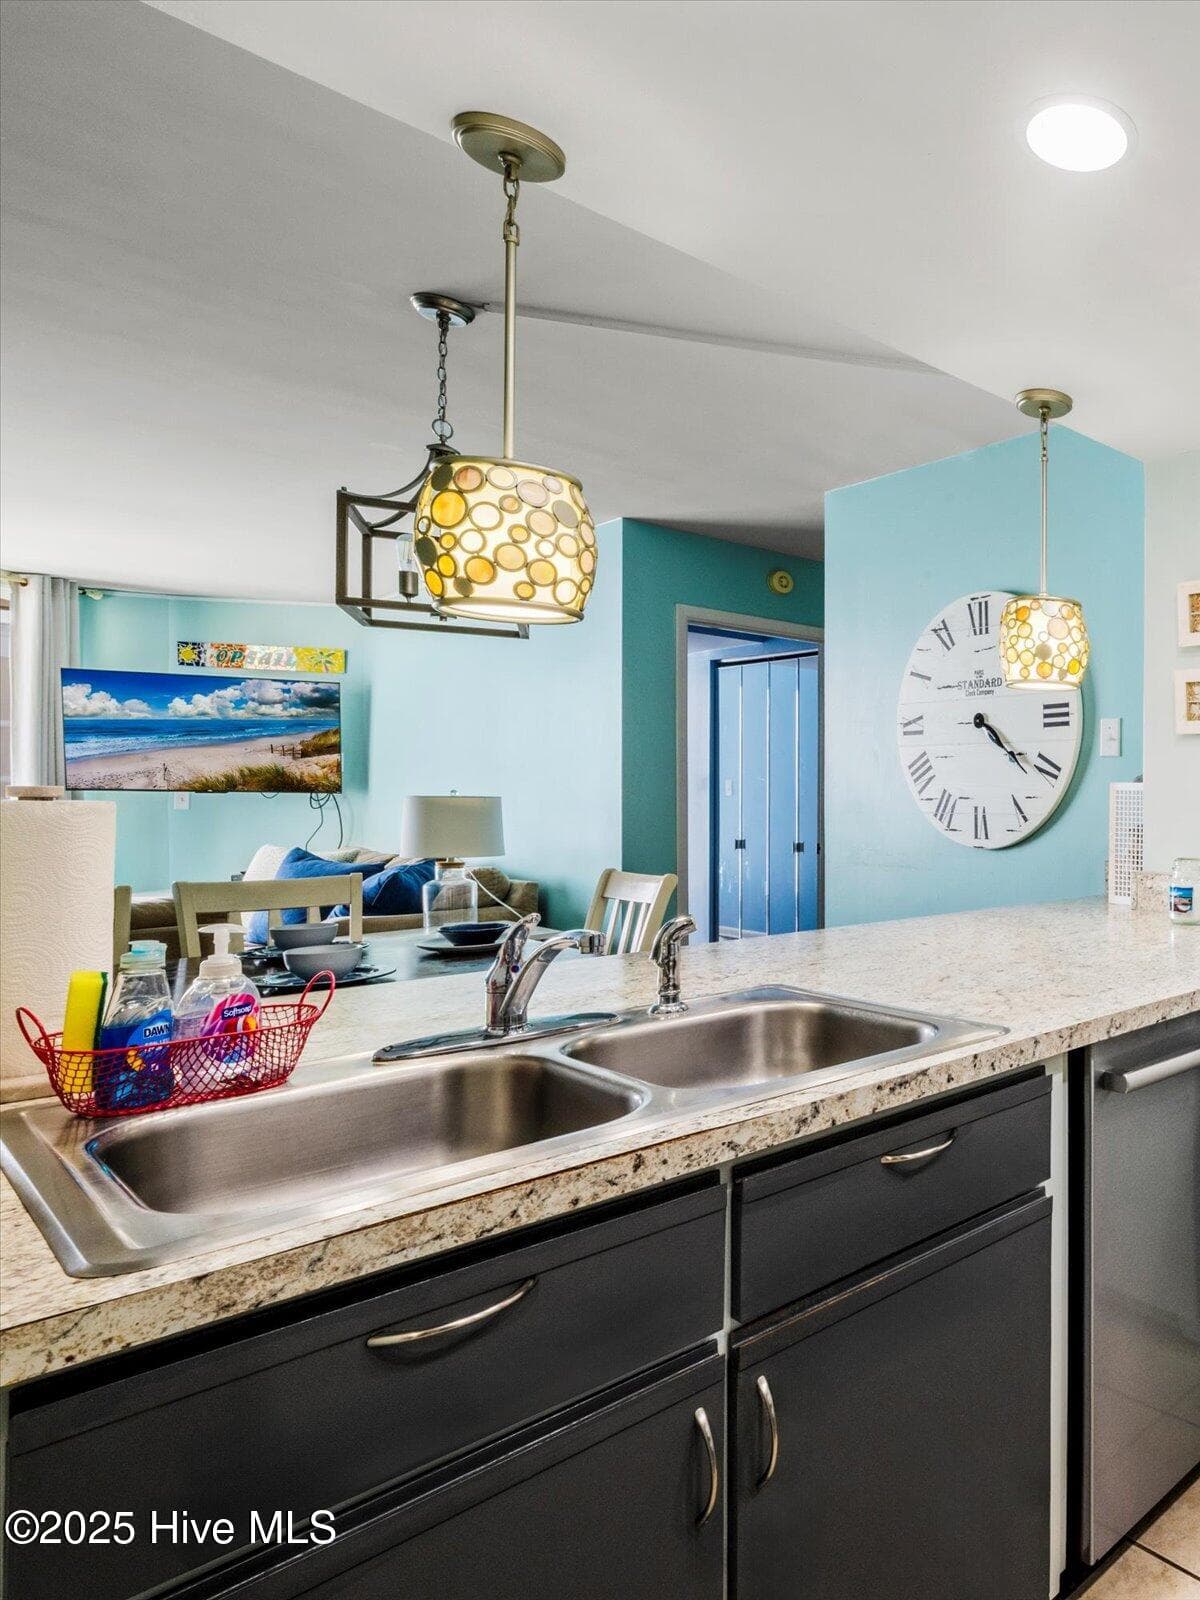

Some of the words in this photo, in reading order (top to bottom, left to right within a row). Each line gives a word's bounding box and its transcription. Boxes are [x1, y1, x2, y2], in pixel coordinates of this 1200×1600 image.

[957, 677, 1002, 690] STANDARD
[223, 1004, 252, 1018] Softsoap
[143, 1023, 171, 1038] DAWN
